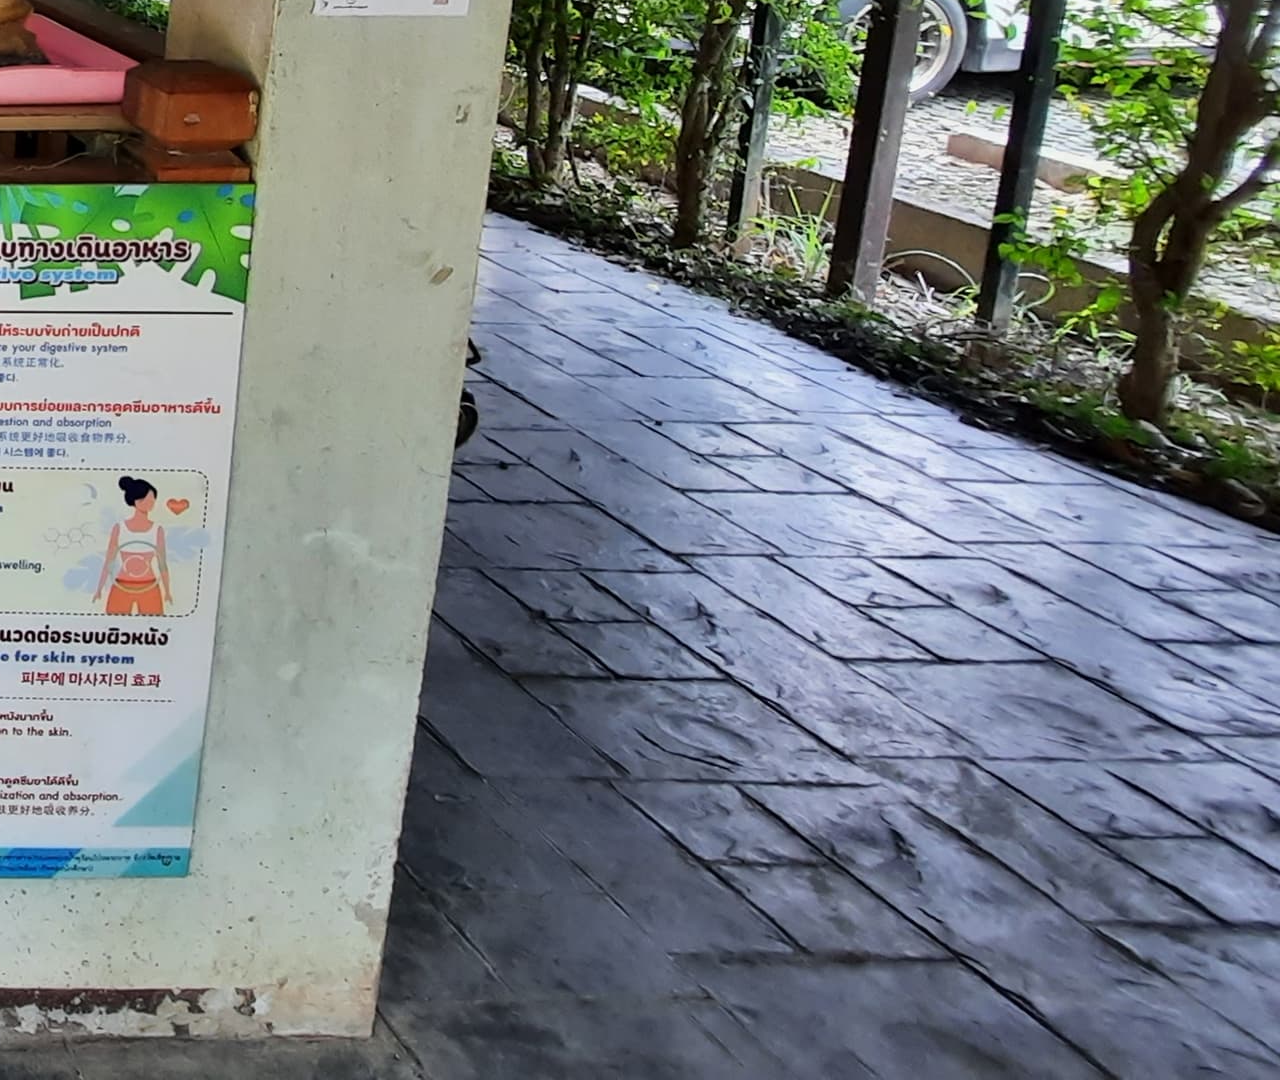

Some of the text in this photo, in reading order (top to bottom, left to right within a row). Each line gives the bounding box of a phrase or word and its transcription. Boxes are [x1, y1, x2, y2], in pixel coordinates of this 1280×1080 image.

[41, 269, 117, 284] system
[12, 344, 36, 355] your
[40, 342, 87, 355] digestive
[91, 344, 128, 355] system
[32, 416, 53, 427] and
[56, 416, 112, 430] absorption
[14, 650, 38, 662] for
[42, 650, 76, 663] skin
[80, 652, 135, 666] system
[21, 671, 162, 688] 피부에 마사지의 효과
[12, 726, 23, 736] to
[26, 726, 45, 737] the
[48, 727, 73, 738] skin.
[39, 791, 60, 801] and
